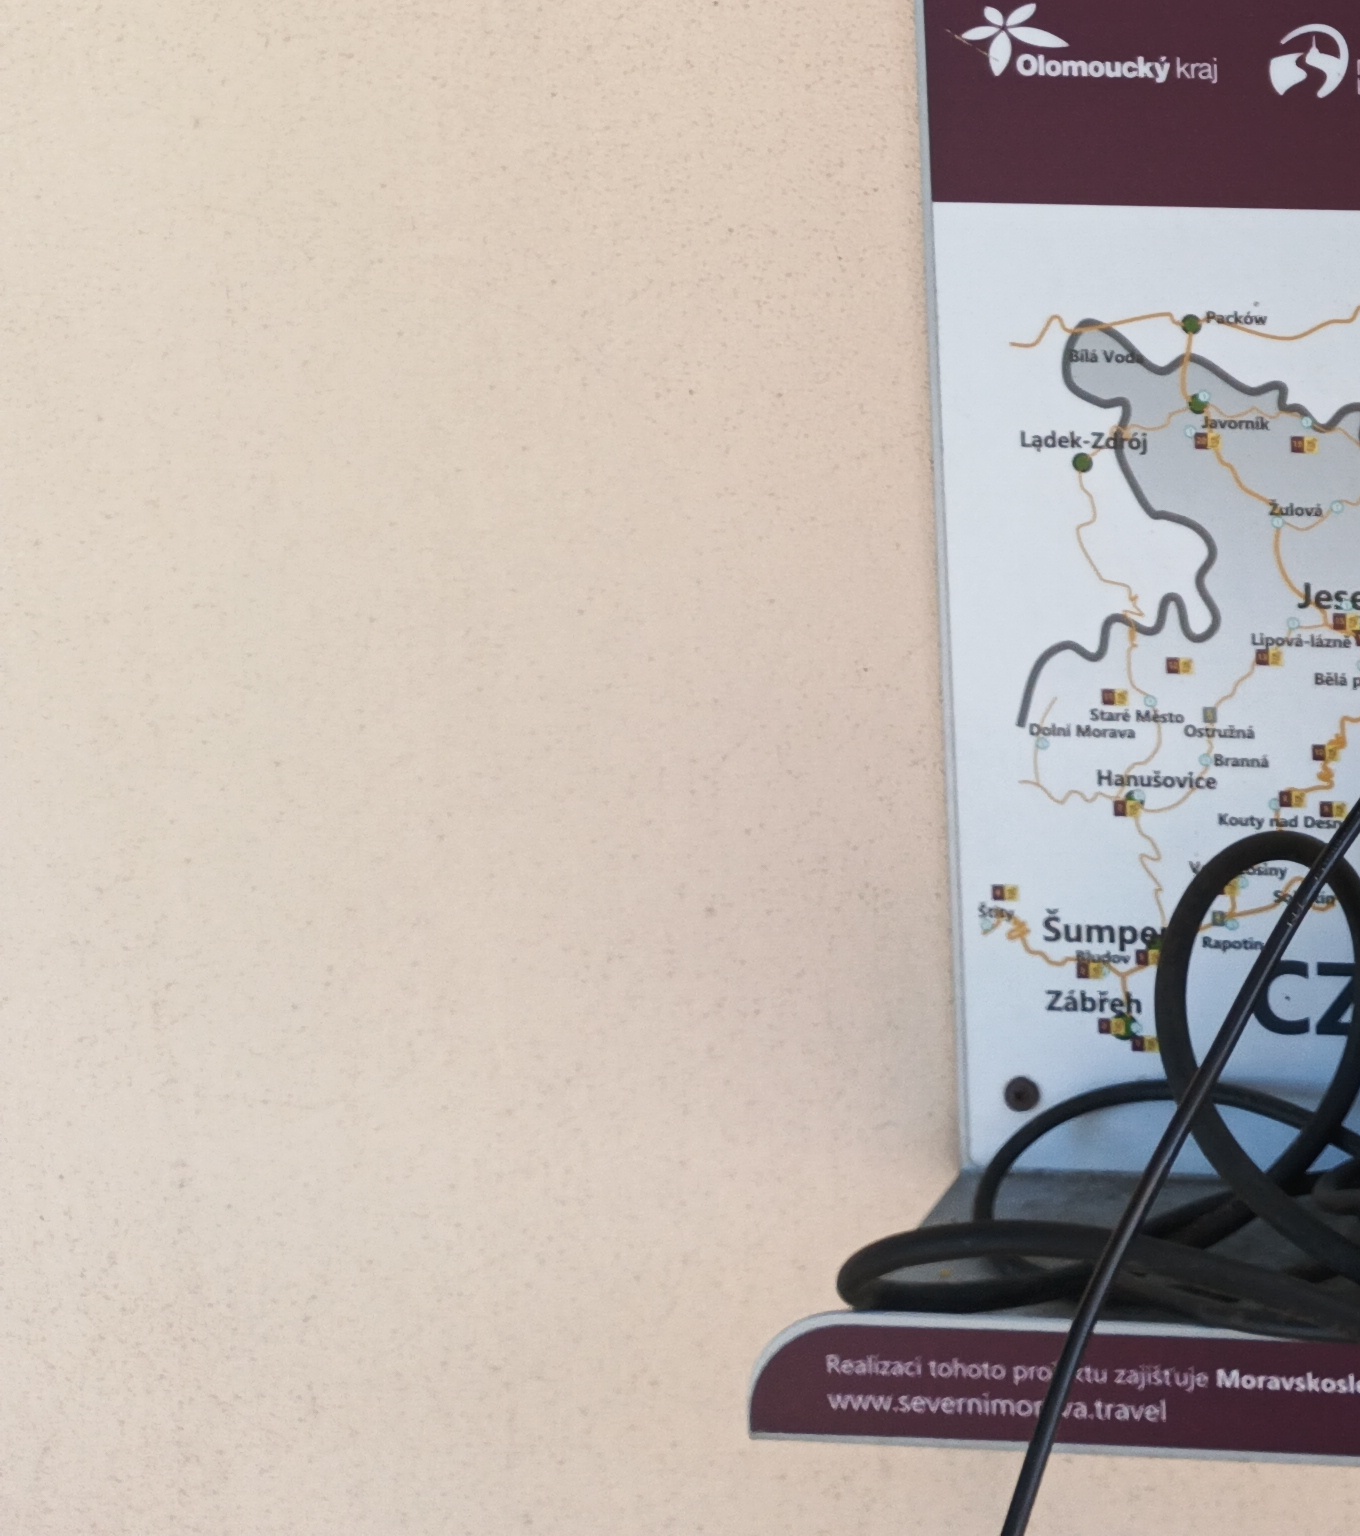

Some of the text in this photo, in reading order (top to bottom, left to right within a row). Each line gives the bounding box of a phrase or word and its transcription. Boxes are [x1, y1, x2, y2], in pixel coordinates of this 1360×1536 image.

[1015, 53, 1218, 84] Olomoucký kraj
[1019, 431, 1149, 454] Lądek-Zdrój
[1269, 501, 1323, 518] Žulová
[1097, 771, 1218, 790] Hanušovice
[1045, 989, 1142, 1014] Zábřeh
[825, 1353, 923, 1378] Realizaci
[927, 1357, 1007, 1381] tohoto
[1113, 1364, 1209, 1394] zajišťuje
[826, 1392, 1167, 1423] www.severnimorva.travel
